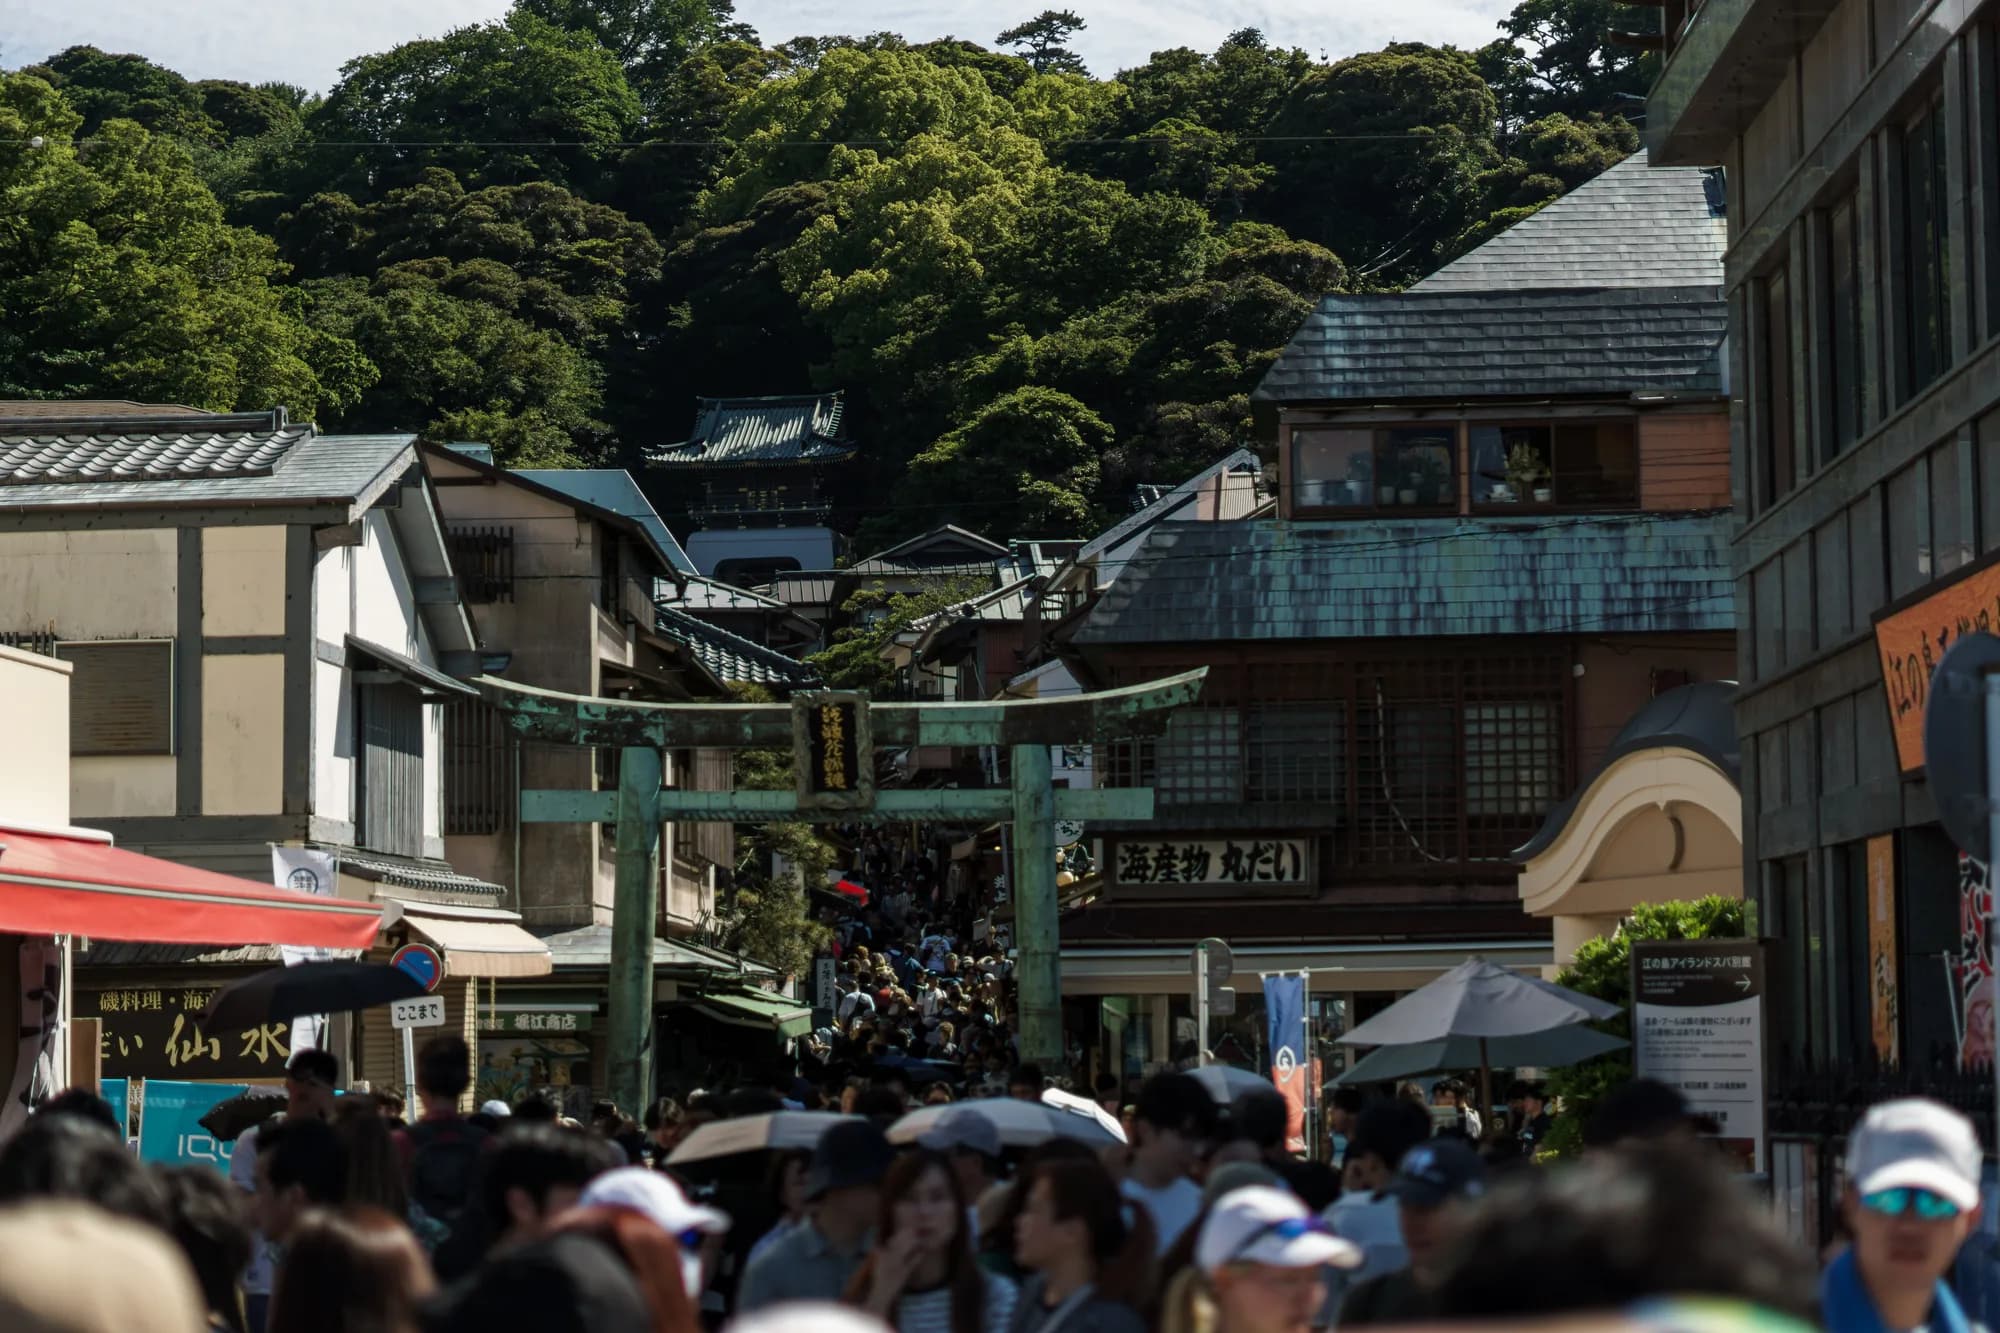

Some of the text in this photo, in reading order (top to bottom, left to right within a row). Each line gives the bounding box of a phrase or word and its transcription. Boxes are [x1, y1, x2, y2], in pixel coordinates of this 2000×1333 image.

[1118, 840, 1302, 883] 海産物 丸だい
[1641, 956, 1753, 970] 江の島アイランドスパ別館
[397, 1003, 438, 1021] ここまで
[514, 1013, 577, 1031] 堀江商店
[164, 1012, 291, 1068] 仙水
